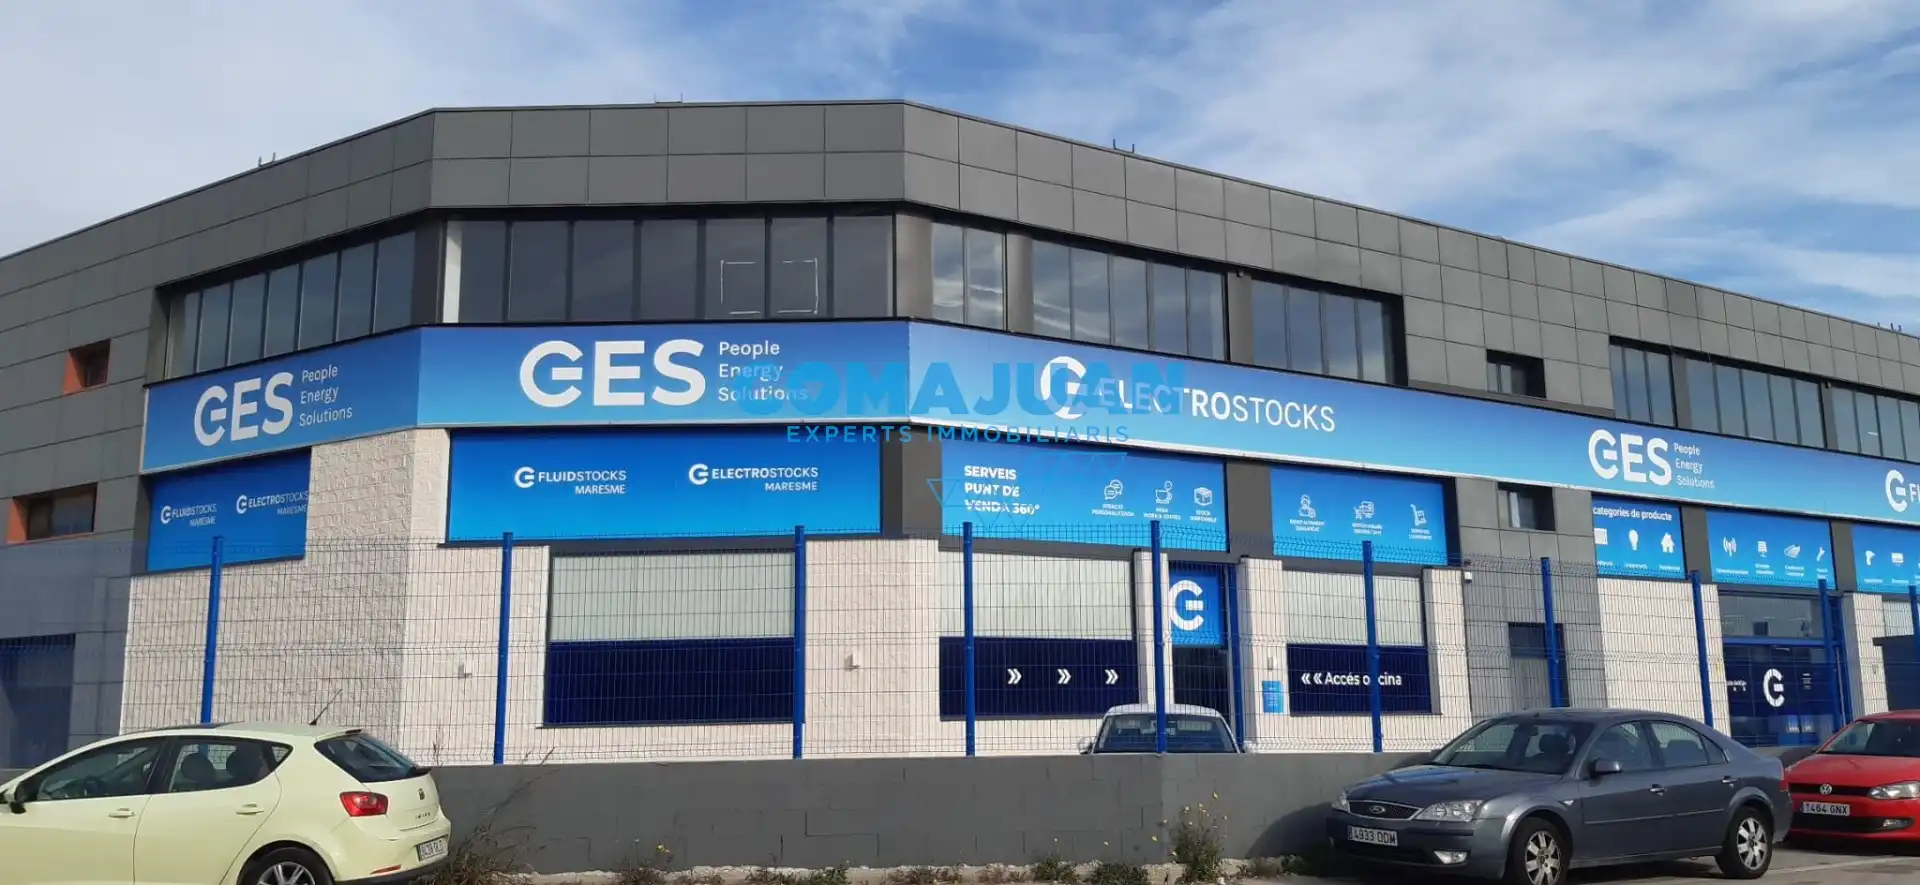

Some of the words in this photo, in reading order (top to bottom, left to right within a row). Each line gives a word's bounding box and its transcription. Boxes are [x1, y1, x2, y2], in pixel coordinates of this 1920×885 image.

[718, 341, 780, 359] People
[302, 364, 338, 383] People
[519, 339, 706, 407] GES
[718, 363, 784, 382] Energy
[300, 386, 339, 404] Energy
[718, 385, 808, 403] Solutions
[194, 372, 293, 446] GES
[1102, 378, 1336, 432] ELECTROSTOCKS
[300, 406, 353, 427] Solutions
[1588, 429, 1672, 486] GES
[1674, 443, 1700, 458] People
[711, 466, 819, 479] ELECTROSTOCKS
[964, 465, 1017, 480] SERVEIS
[1676, 458, 1703, 475] Energy
[538, 470, 627, 482] FLUIDSTOCKS
[1677, 474, 1715, 489] Solutions
[575, 483, 626, 494] MARESME
[765, 480, 819, 491] MARESME
[964, 482, 1000, 495] PUNT
[1002, 485, 1020, 497] DE
[964, 499, 1010, 512] VENDA
[1592, 507, 1630, 518] categories
[1630, 509, 1640, 518] de
[1641, 511, 1673, 521] producte
[1325, 672, 1360, 686] Accés
[1362, 672, 1402, 686] ocina
